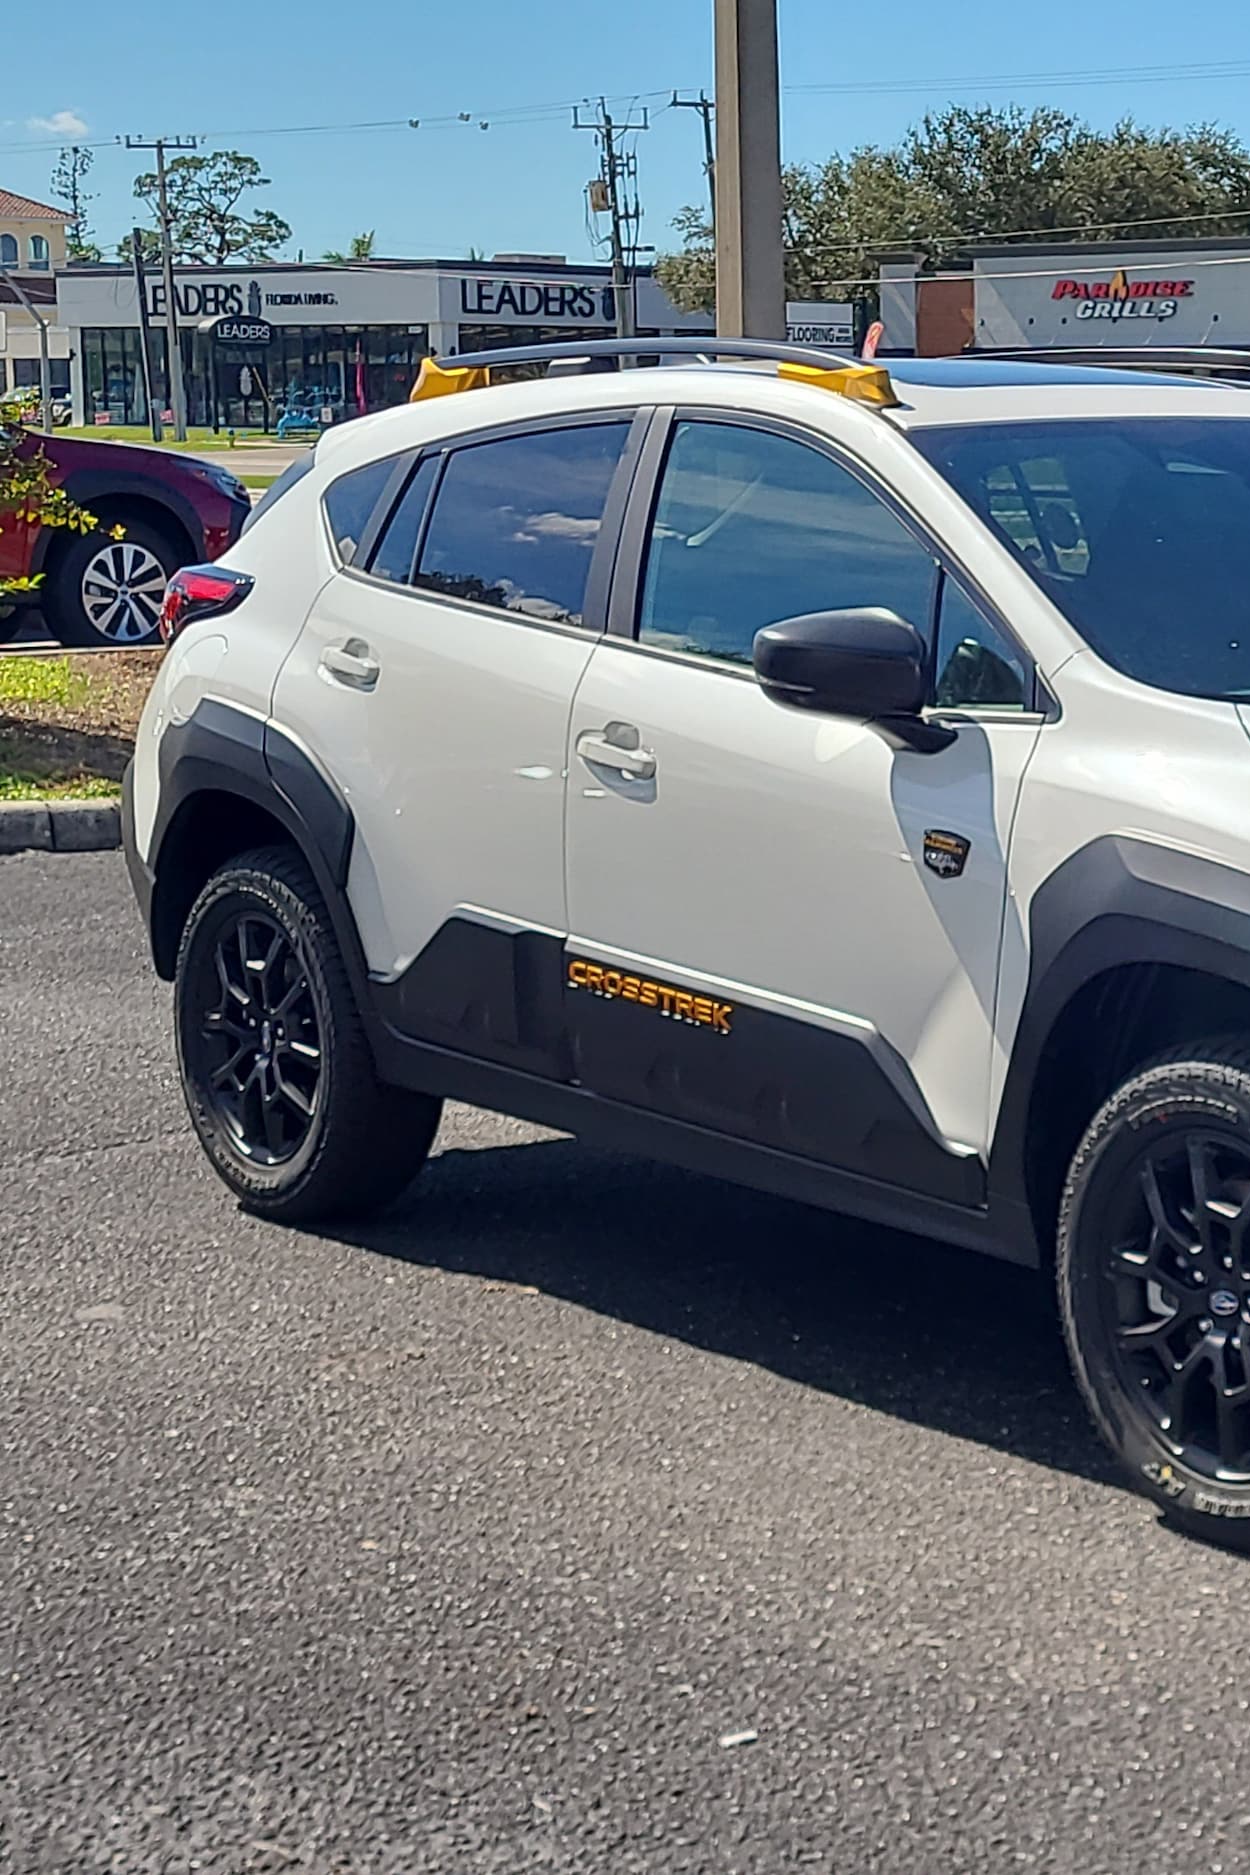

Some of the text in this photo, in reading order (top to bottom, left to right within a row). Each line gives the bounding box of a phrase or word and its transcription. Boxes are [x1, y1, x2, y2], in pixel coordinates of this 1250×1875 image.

[460, 278, 596, 318] LEADERS
[1075, 300, 1177, 319] GRILLS
[217, 324, 271, 339] LEADERS
[568, 960, 733, 1034] CROSSTREK
